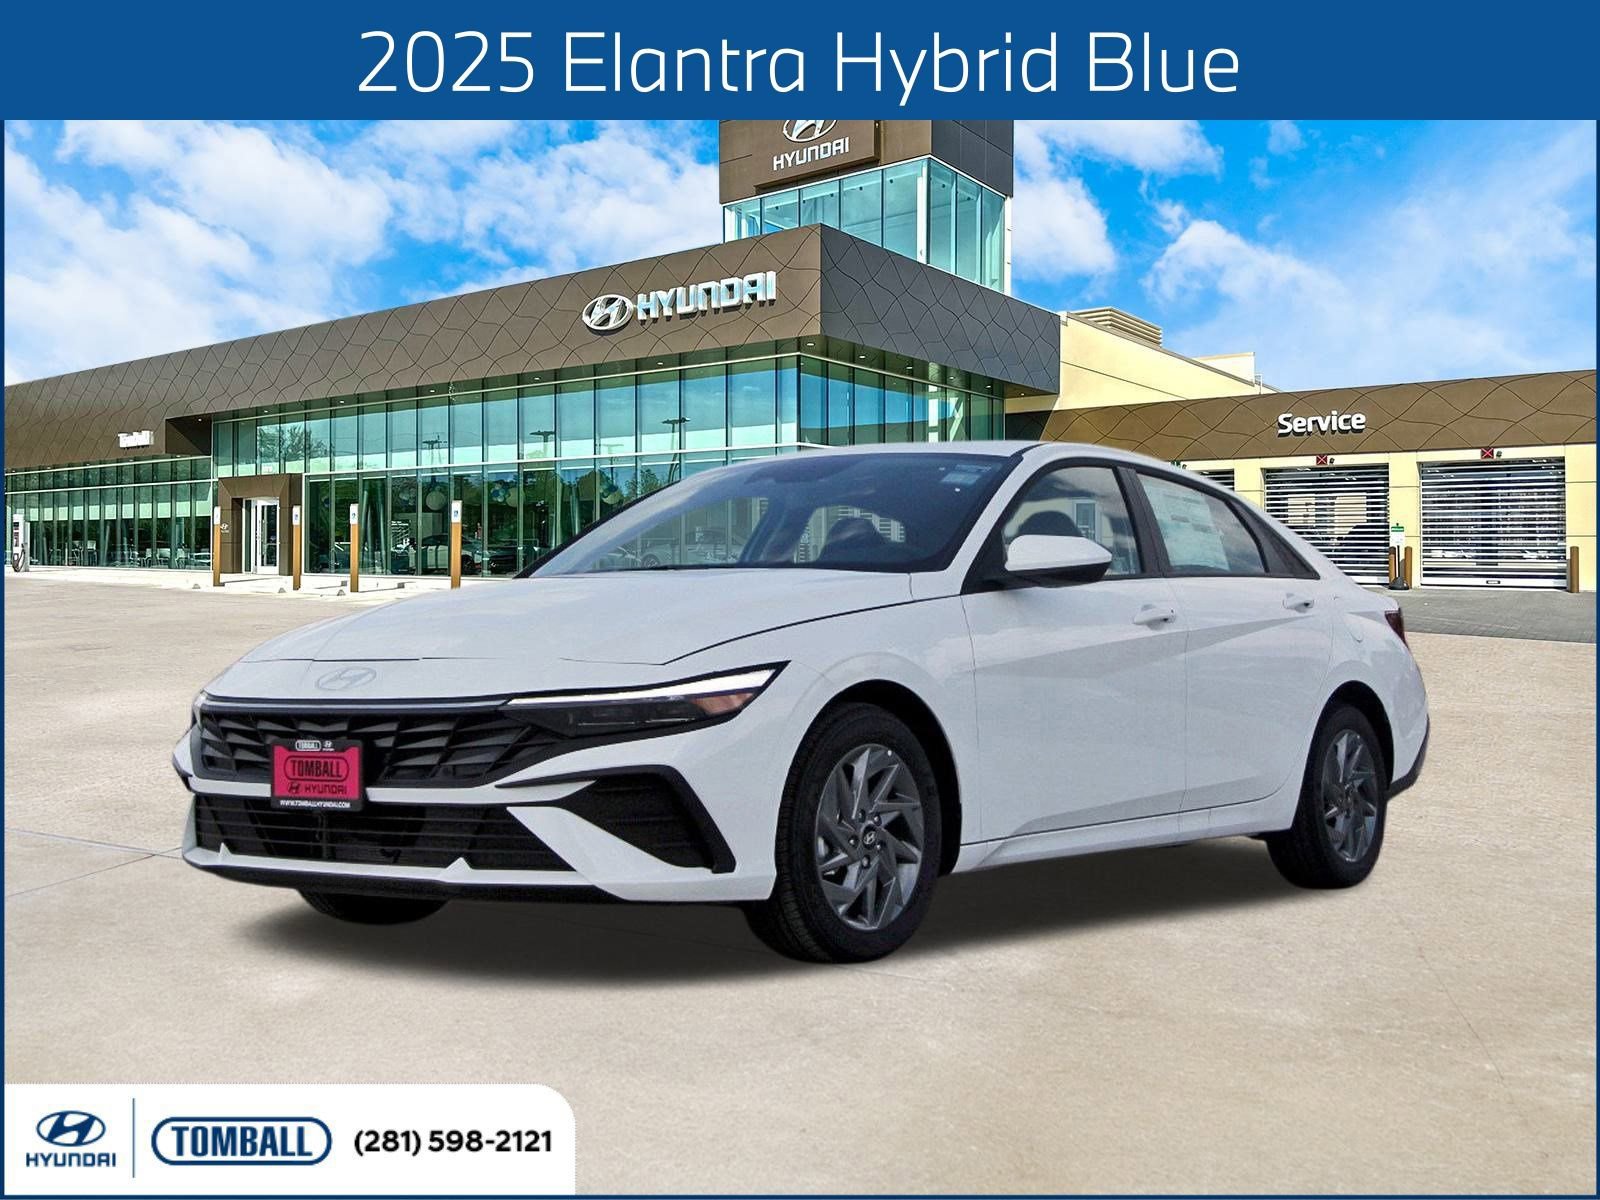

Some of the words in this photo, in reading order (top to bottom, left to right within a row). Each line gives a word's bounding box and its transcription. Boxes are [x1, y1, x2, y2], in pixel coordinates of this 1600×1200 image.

[773, 136, 850, 171] HYUNDAI
[637, 270, 777, 321] HYUNDAI
[1277, 410, 1367, 435] Service
[290, 760, 342, 777] TOMBALL
[304, 783, 347, 794] HYUNDAI
